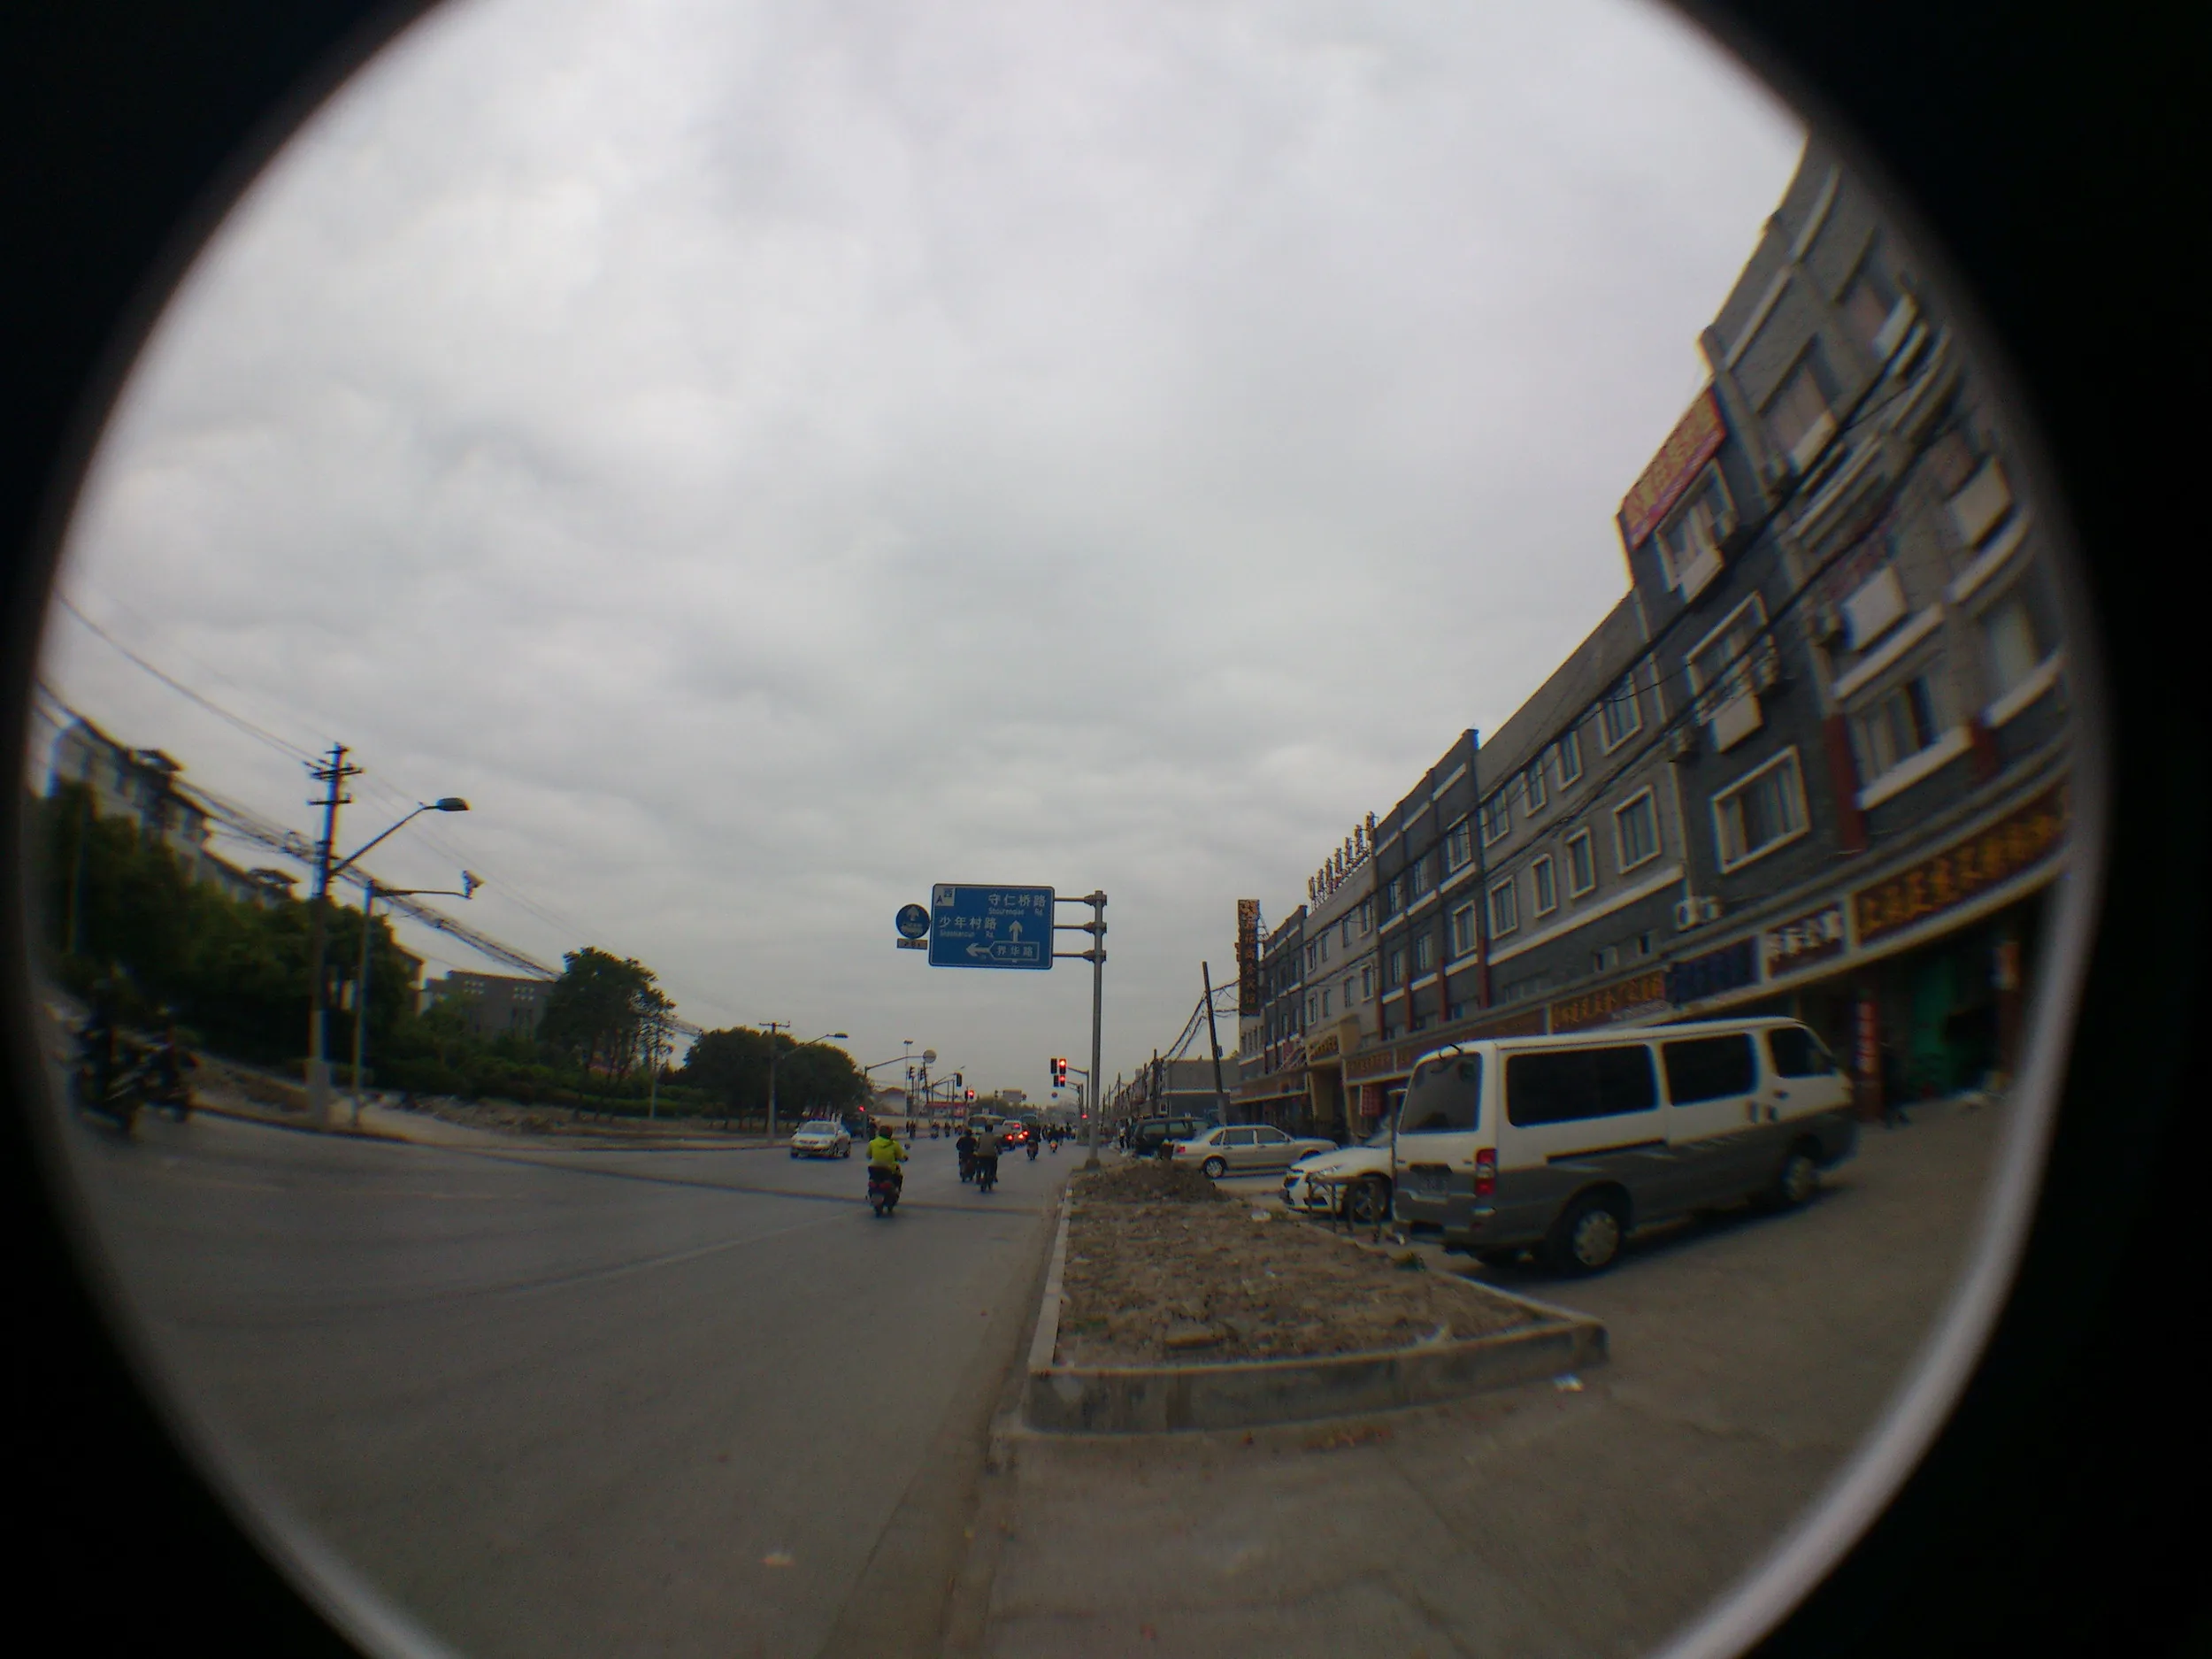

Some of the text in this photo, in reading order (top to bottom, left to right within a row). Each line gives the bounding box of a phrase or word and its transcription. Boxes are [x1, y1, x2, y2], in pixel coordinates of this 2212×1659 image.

[988, 893, 1046, 906] 守仁桥路
[939, 916, 997, 929] 少年村路
